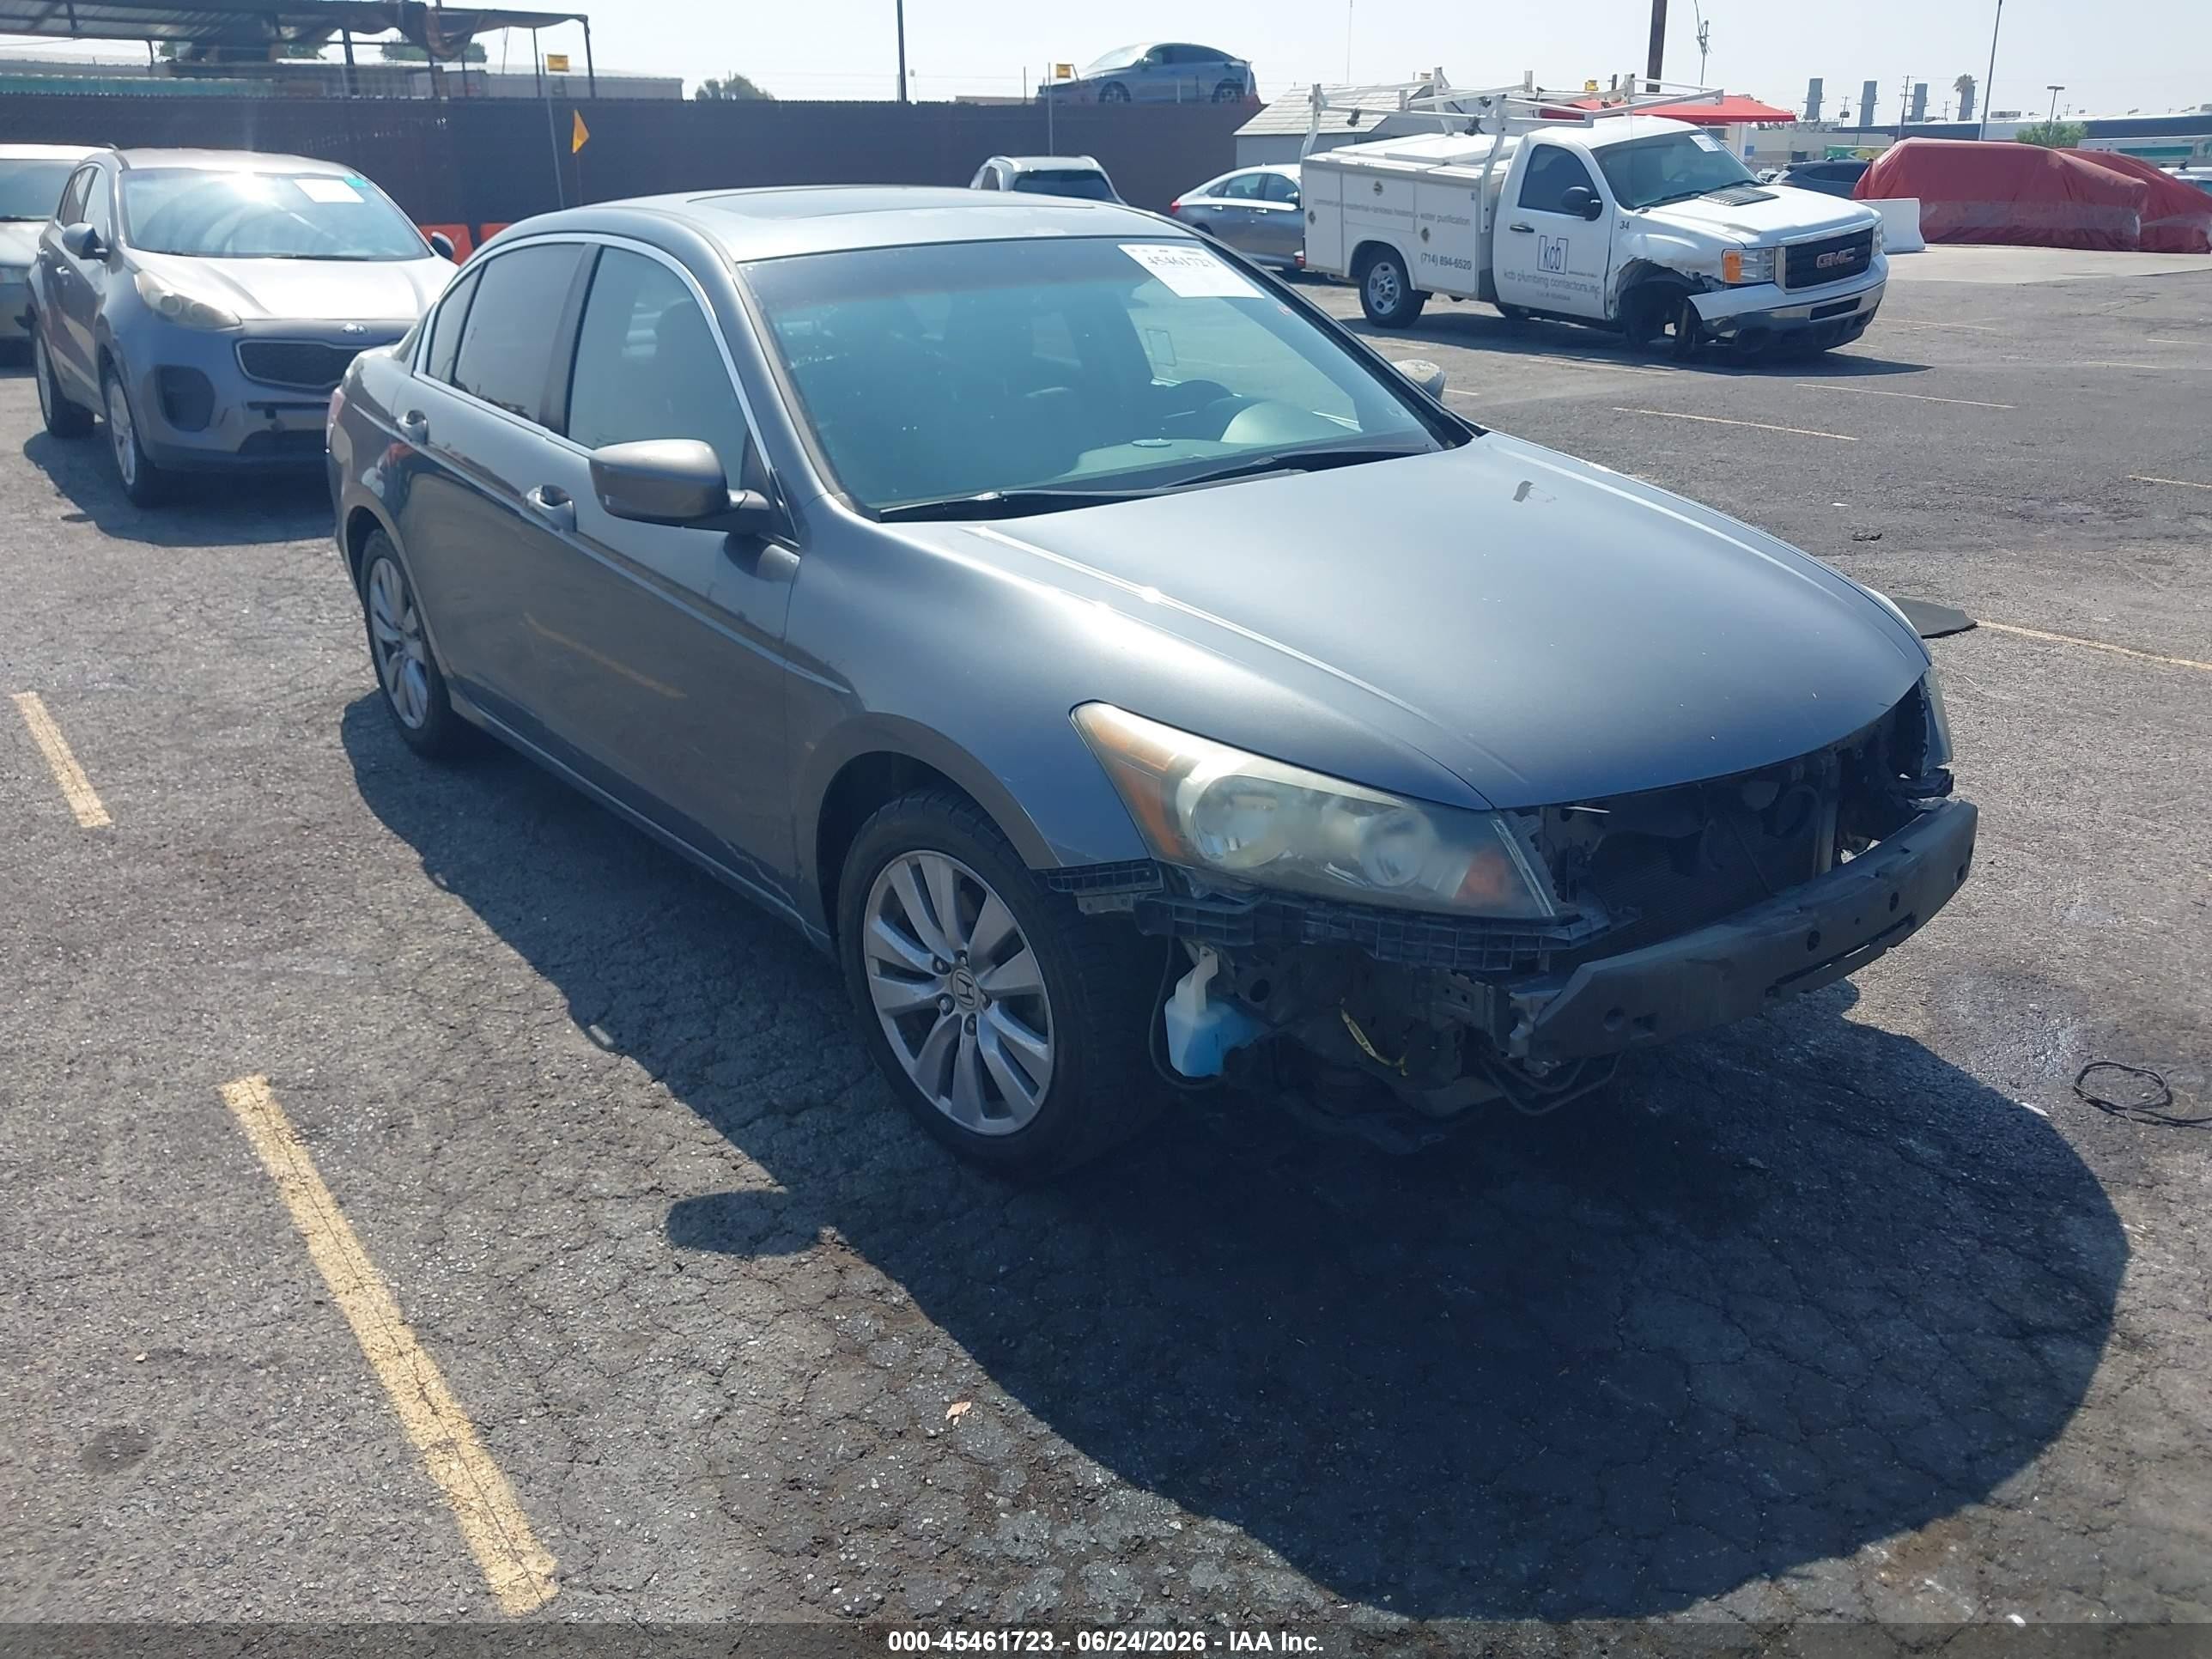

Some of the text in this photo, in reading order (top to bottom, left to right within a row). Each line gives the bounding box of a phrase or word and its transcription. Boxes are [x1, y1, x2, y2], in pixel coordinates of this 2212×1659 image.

[1619, 220, 1630, 230] 34
[1420, 252, 1438, 266] (714)
[1816, 247, 1856, 268] GMC
[1517, 269, 1549, 289] plumbing
